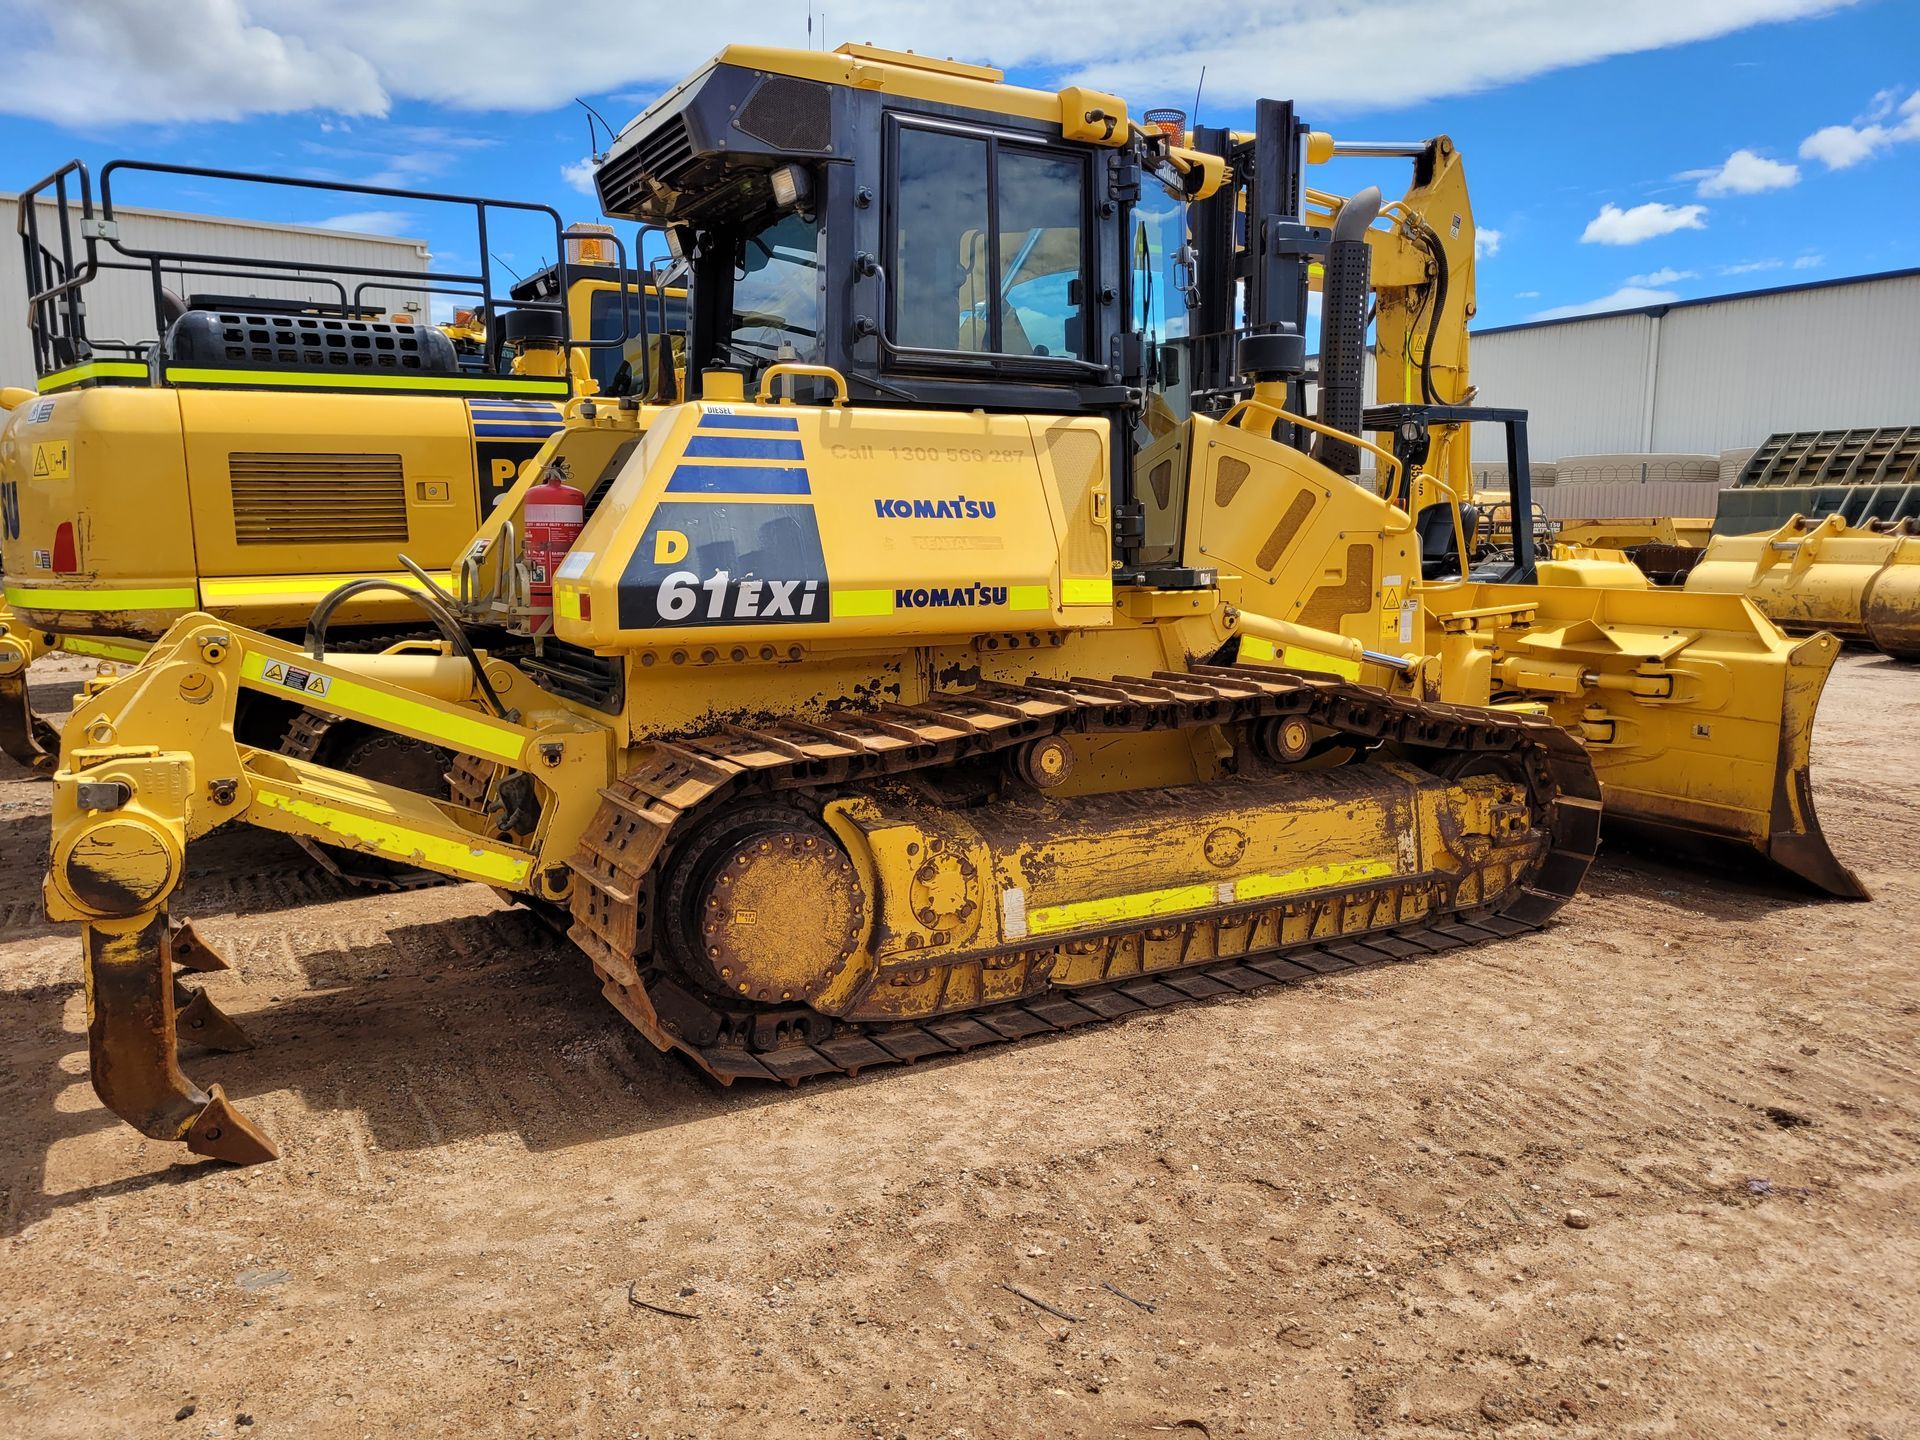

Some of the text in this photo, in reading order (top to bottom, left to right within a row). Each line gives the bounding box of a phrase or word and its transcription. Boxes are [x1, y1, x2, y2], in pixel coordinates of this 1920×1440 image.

[706, 406, 732, 415] DIESEL
[831, 444, 1024, 464] Call 1300 566 287
[874, 495, 997, 518] KOMATSU
[654, 530, 689, 565] D
[656, 570, 818, 620] 61EXi
[895, 581, 1007, 608] KOMATSU
